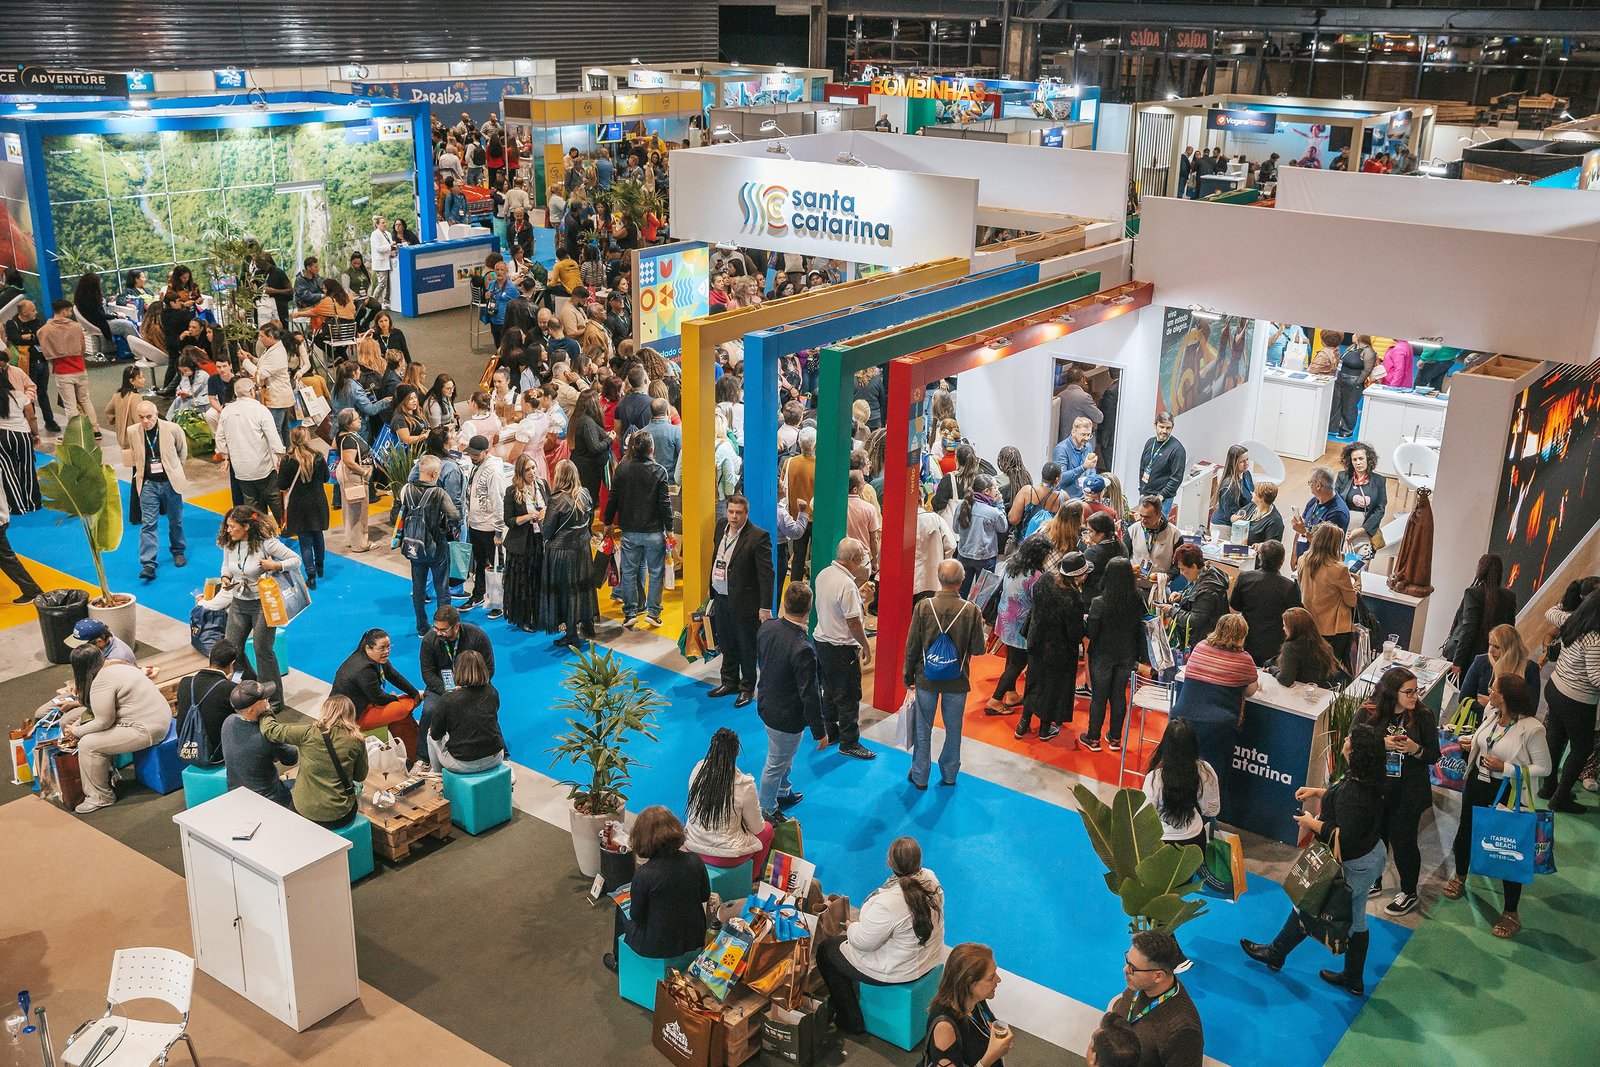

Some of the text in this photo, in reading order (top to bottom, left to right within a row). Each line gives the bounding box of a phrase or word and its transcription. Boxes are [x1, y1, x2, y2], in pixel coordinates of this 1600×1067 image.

[1130, 28, 1160, 46] SAÍDA
[1176, 30, 1207, 48] SAÍDA
[30, 74, 107, 85] ADVENTURE
[871, 76, 987, 102] BOMBINHAS
[791, 189, 856, 213] santa
[791, 209, 891, 241] catarina
[1234, 745, 1269, 765] anta
[1232, 758, 1293, 785] atarina
[1490, 835, 1517, 844] ITAPEMA
[1495, 841, 1517, 850] BEACH
